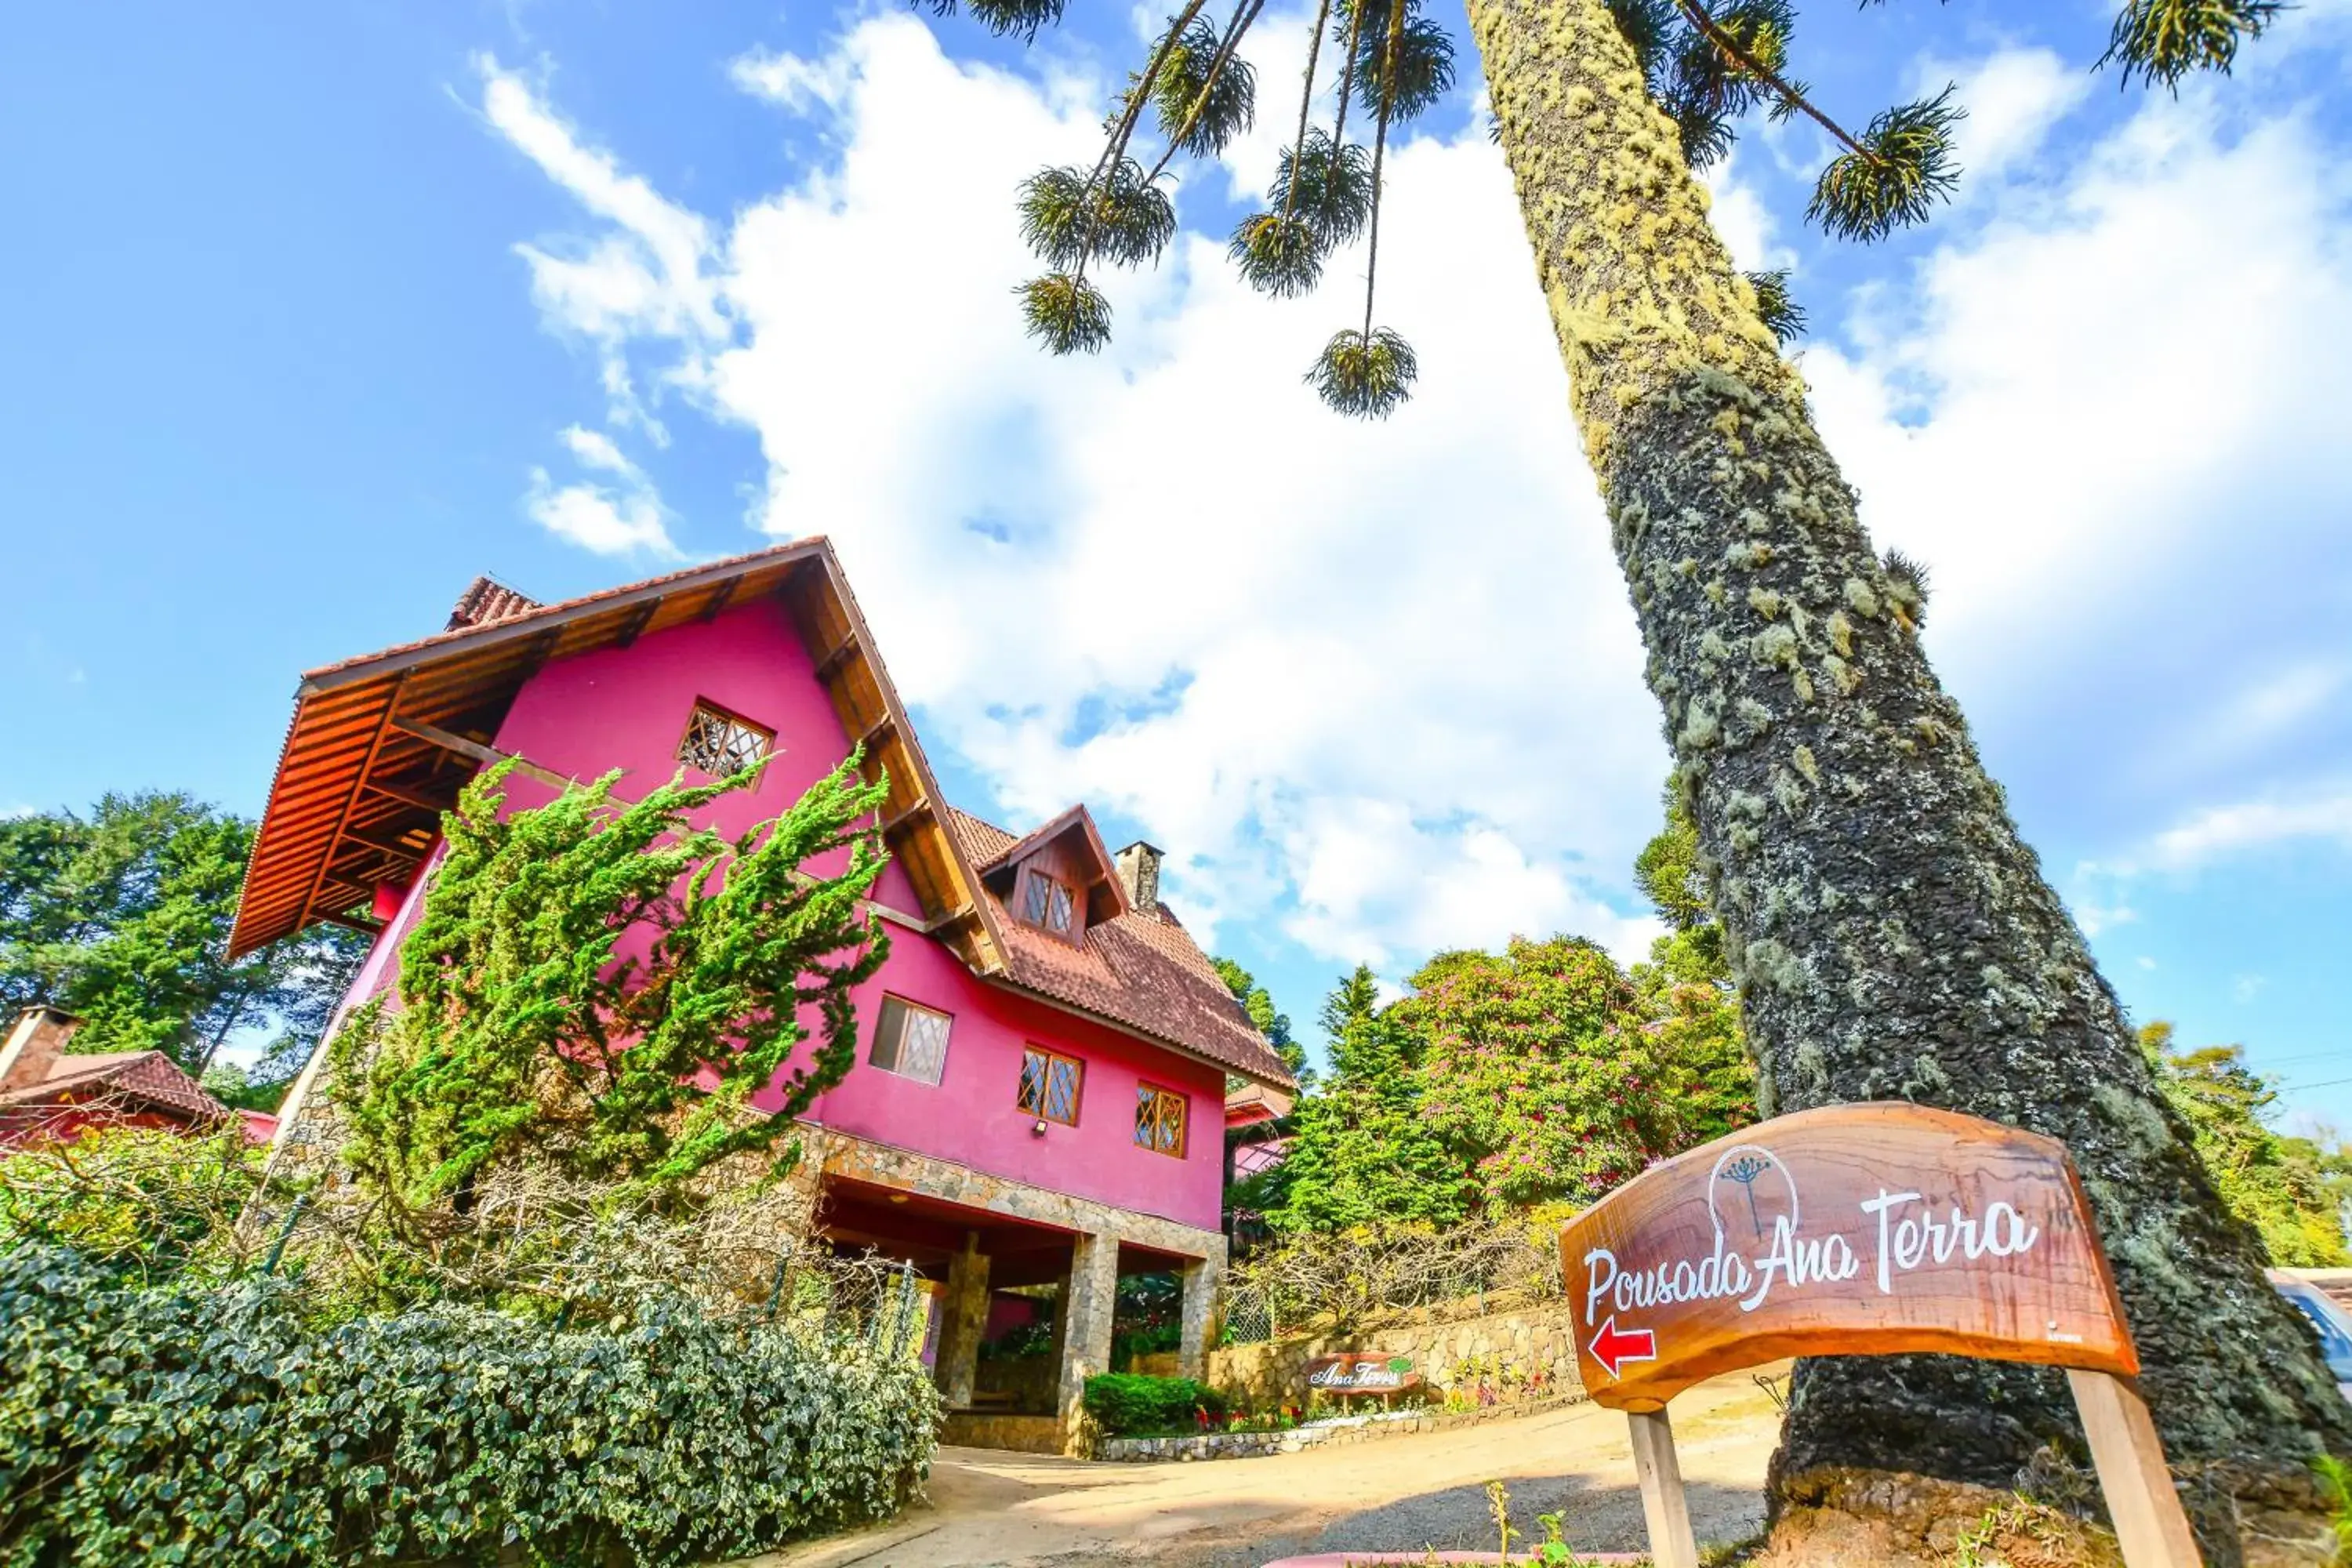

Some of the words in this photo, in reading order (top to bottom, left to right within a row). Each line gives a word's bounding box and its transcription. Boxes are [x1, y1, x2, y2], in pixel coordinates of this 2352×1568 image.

[1584, 1229, 1752, 1327] Pousada
[1739, 1214, 1859, 1312] Ana
[1860, 1188, 2038, 1294] Terra
[1310, 1362, 1355, 1385] Ana
[1355, 1362, 1399, 1386] Terra
